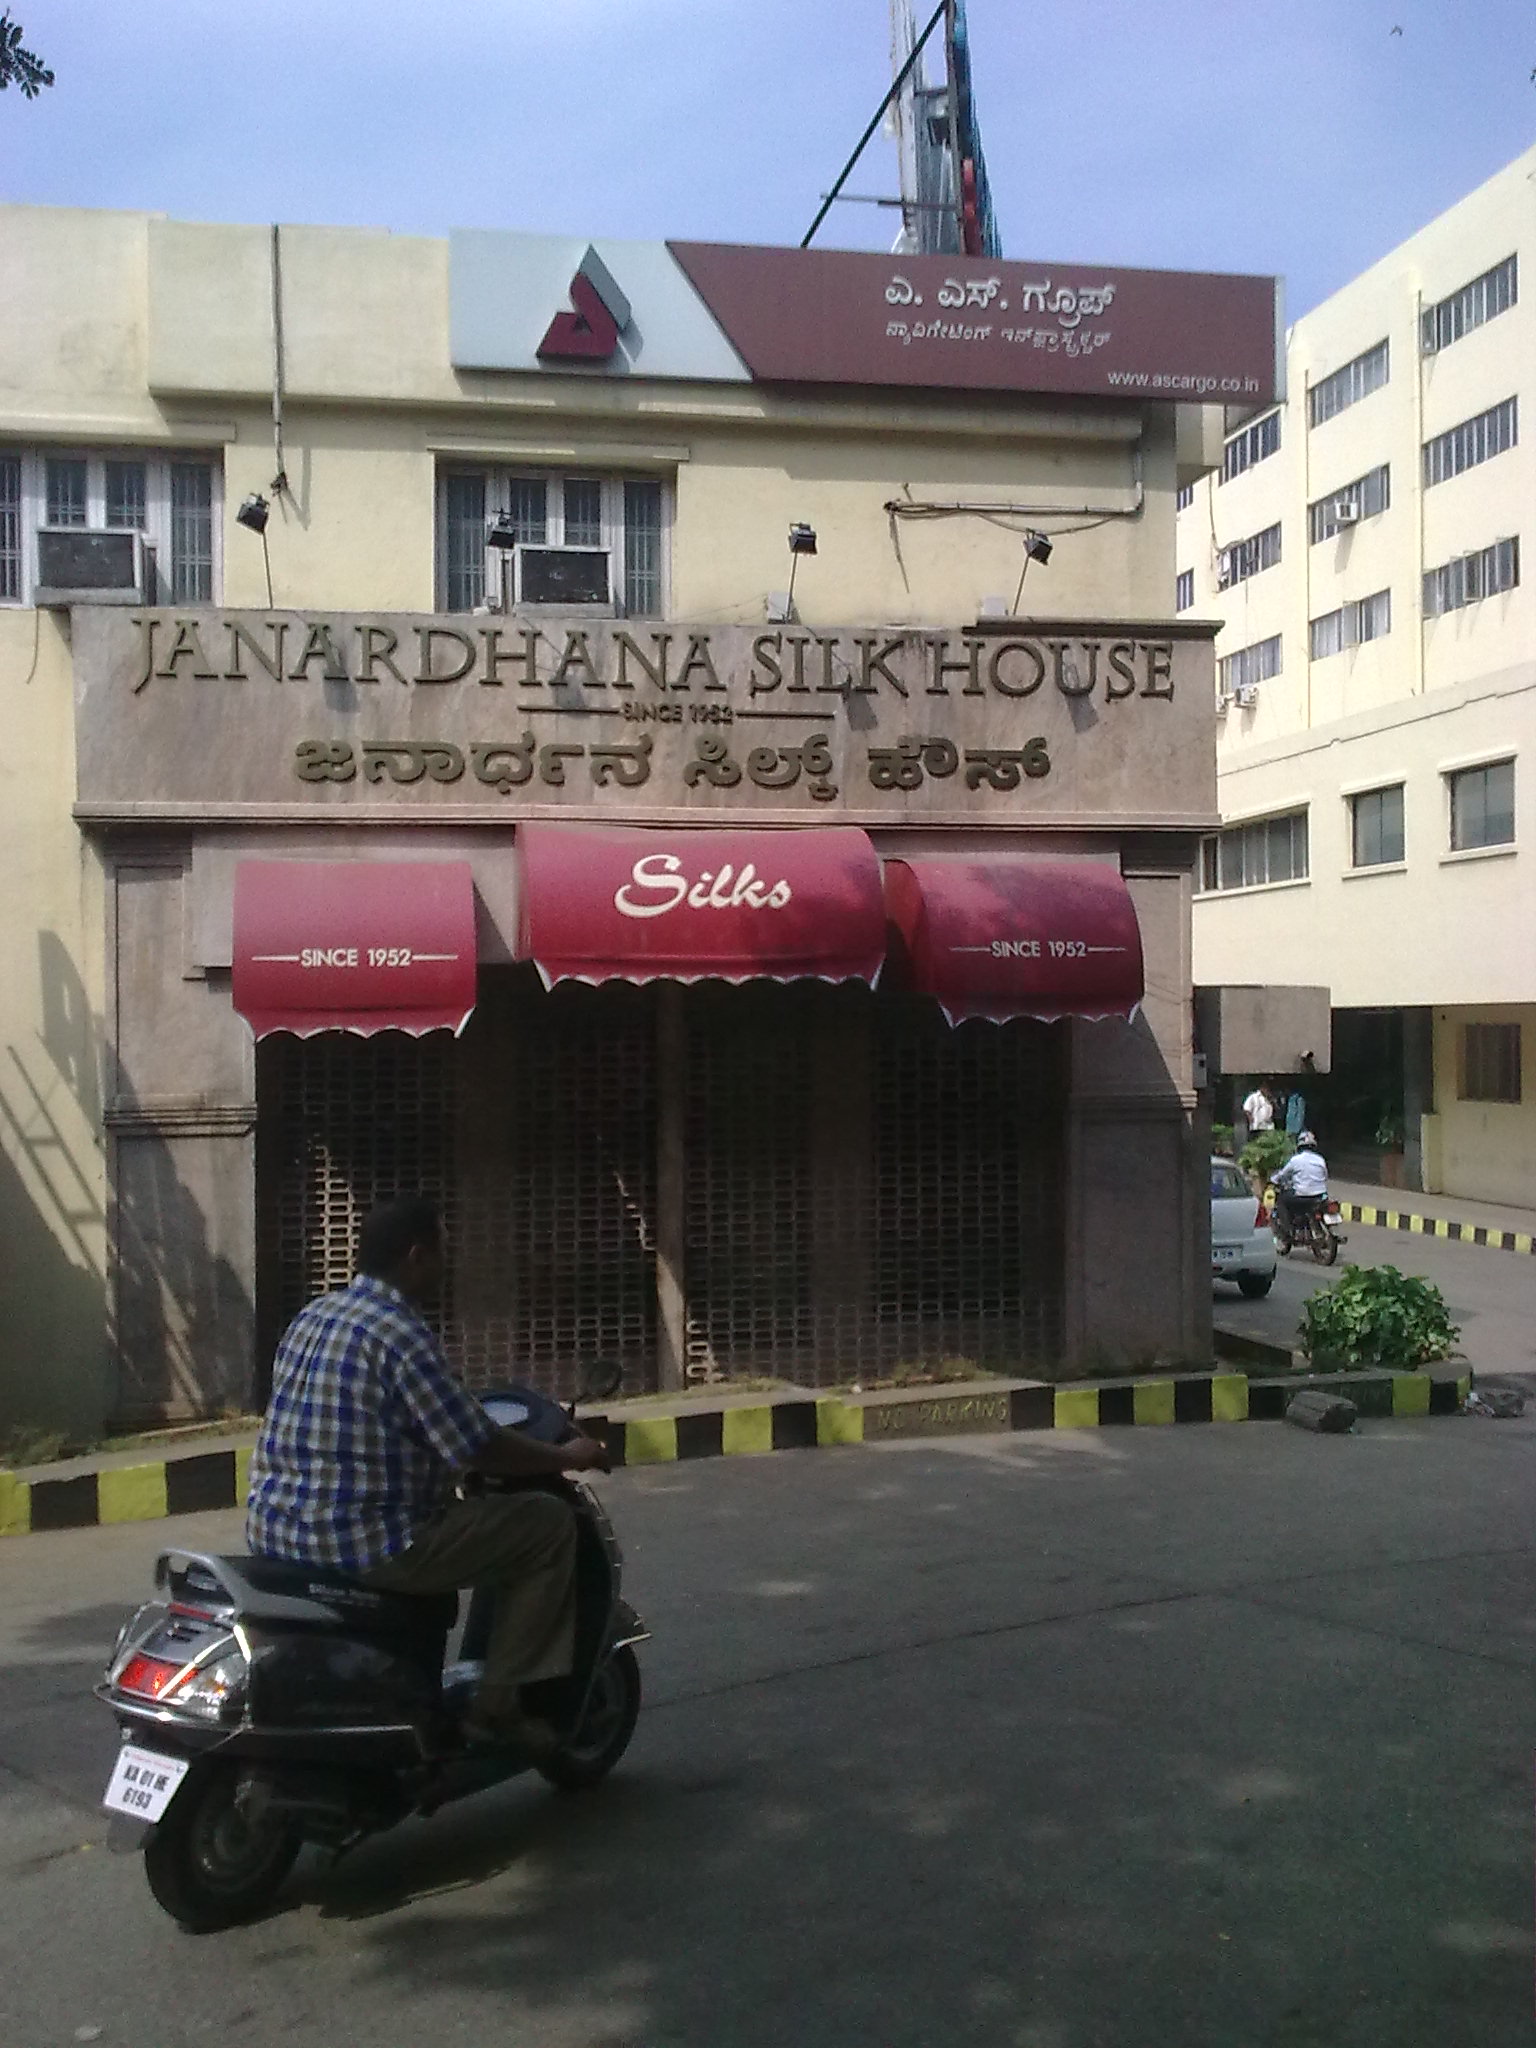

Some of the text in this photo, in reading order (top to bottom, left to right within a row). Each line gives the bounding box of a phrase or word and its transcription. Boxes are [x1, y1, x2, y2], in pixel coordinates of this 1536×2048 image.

[1022, 280, 1116, 329] ಗ್ರೂಪ್
[1107, 371, 1260, 394] www.ascargo.co.in
[131, 618, 1176, 702] JANARDHANA SILK HOUSE
[623, 702, 683, 723] SINCE
[296, 730, 1051, 801] ಜನಾರ್ಧನ ಸಿಲ್ಕ್ ಹೌಸ್
[613, 853, 794, 919] Silks
[300, 947, 412, 968] SINCE 1952
[991, 940, 1087, 959] SINCE 1952
